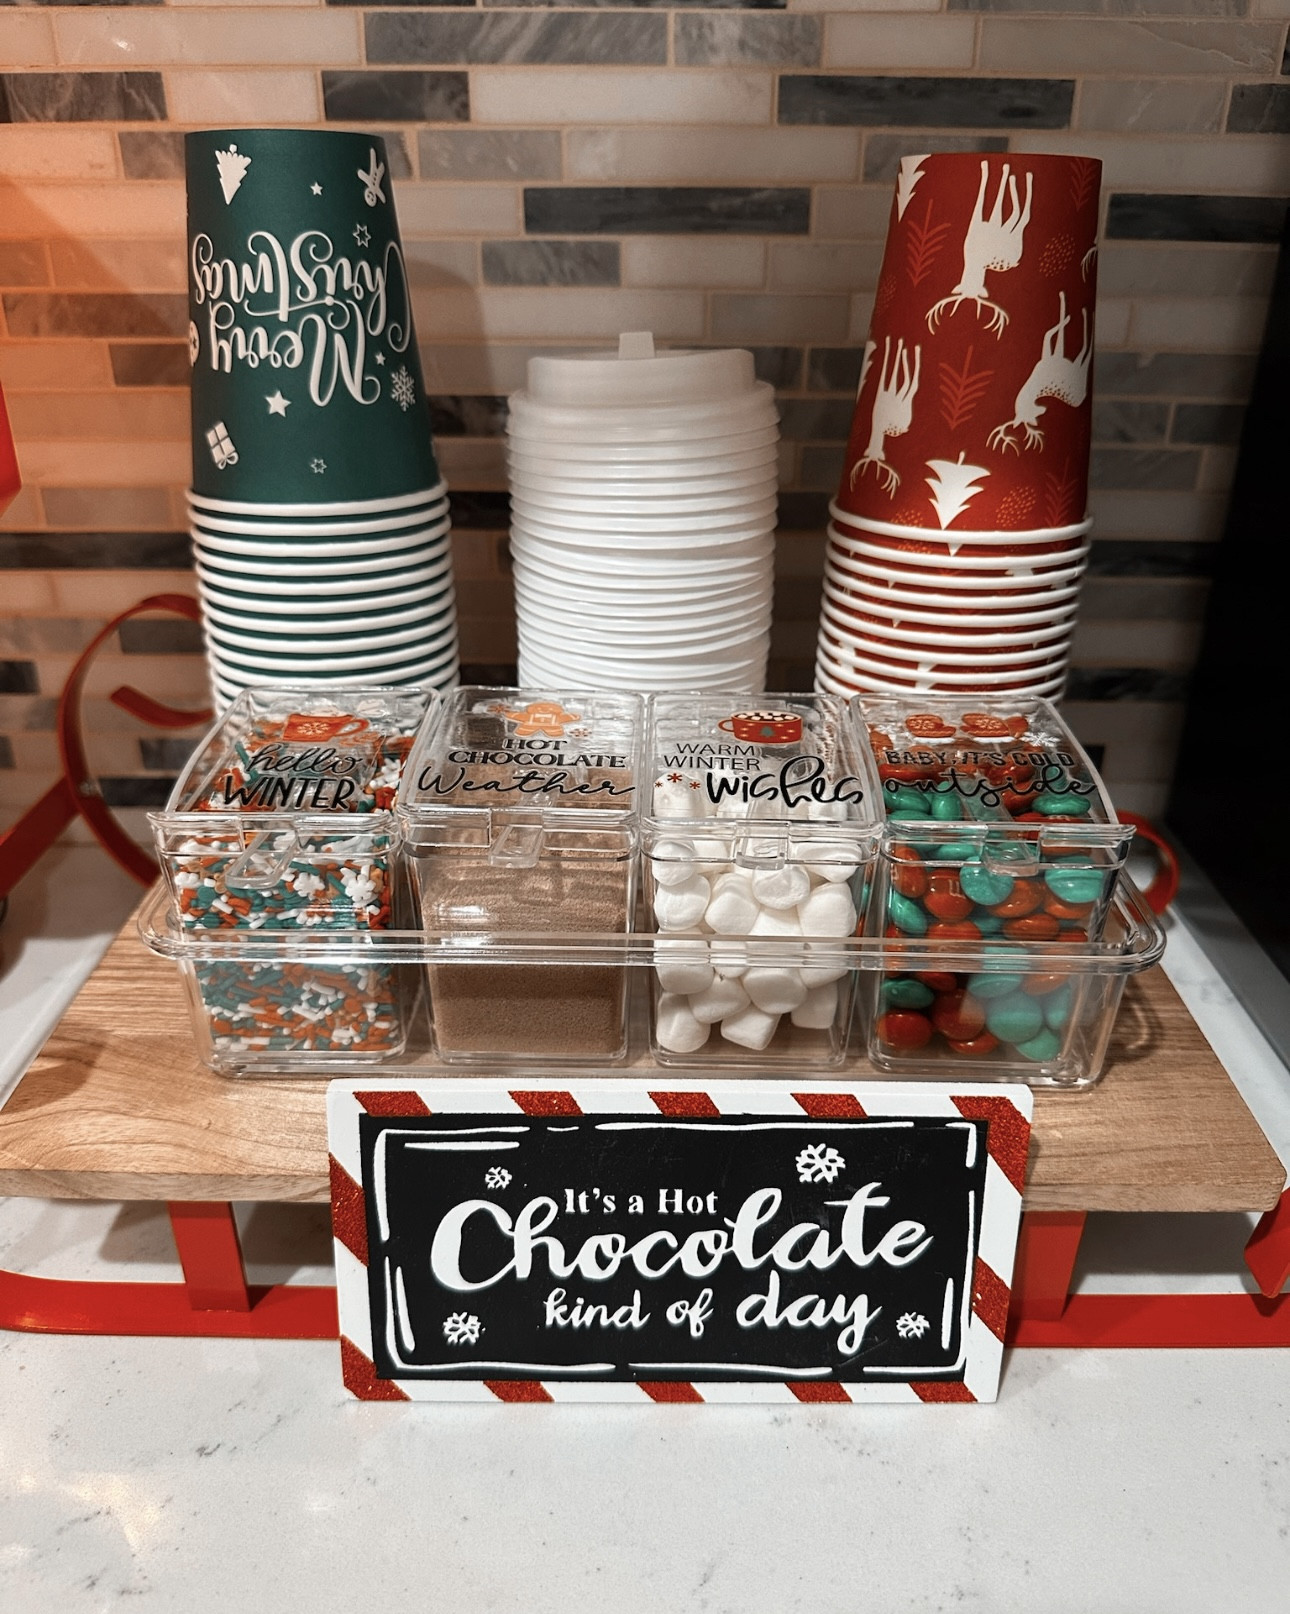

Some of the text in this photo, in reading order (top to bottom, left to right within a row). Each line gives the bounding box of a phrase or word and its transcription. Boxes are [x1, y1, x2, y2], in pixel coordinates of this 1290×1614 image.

[192, 230, 411, 353] Christmas
[208, 297, 381, 407] Merry
[246, 742, 363, 773] hello
[448, 751, 626, 768] CHOCOLATE
[505, 738, 568, 751] HOT
[676, 743, 756, 756] WARM
[1013, 752, 1075, 767] COLD
[664, 755, 762, 771] WINTER
[223, 776, 356, 811] WINTER
[417, 765, 636, 798] Weather
[885, 767, 1098, 808] outside
[565, 1188, 719, 1215] It's a Hot
[429, 1181, 934, 1291] Chocolate
[543, 1270, 884, 1355] kind of day
